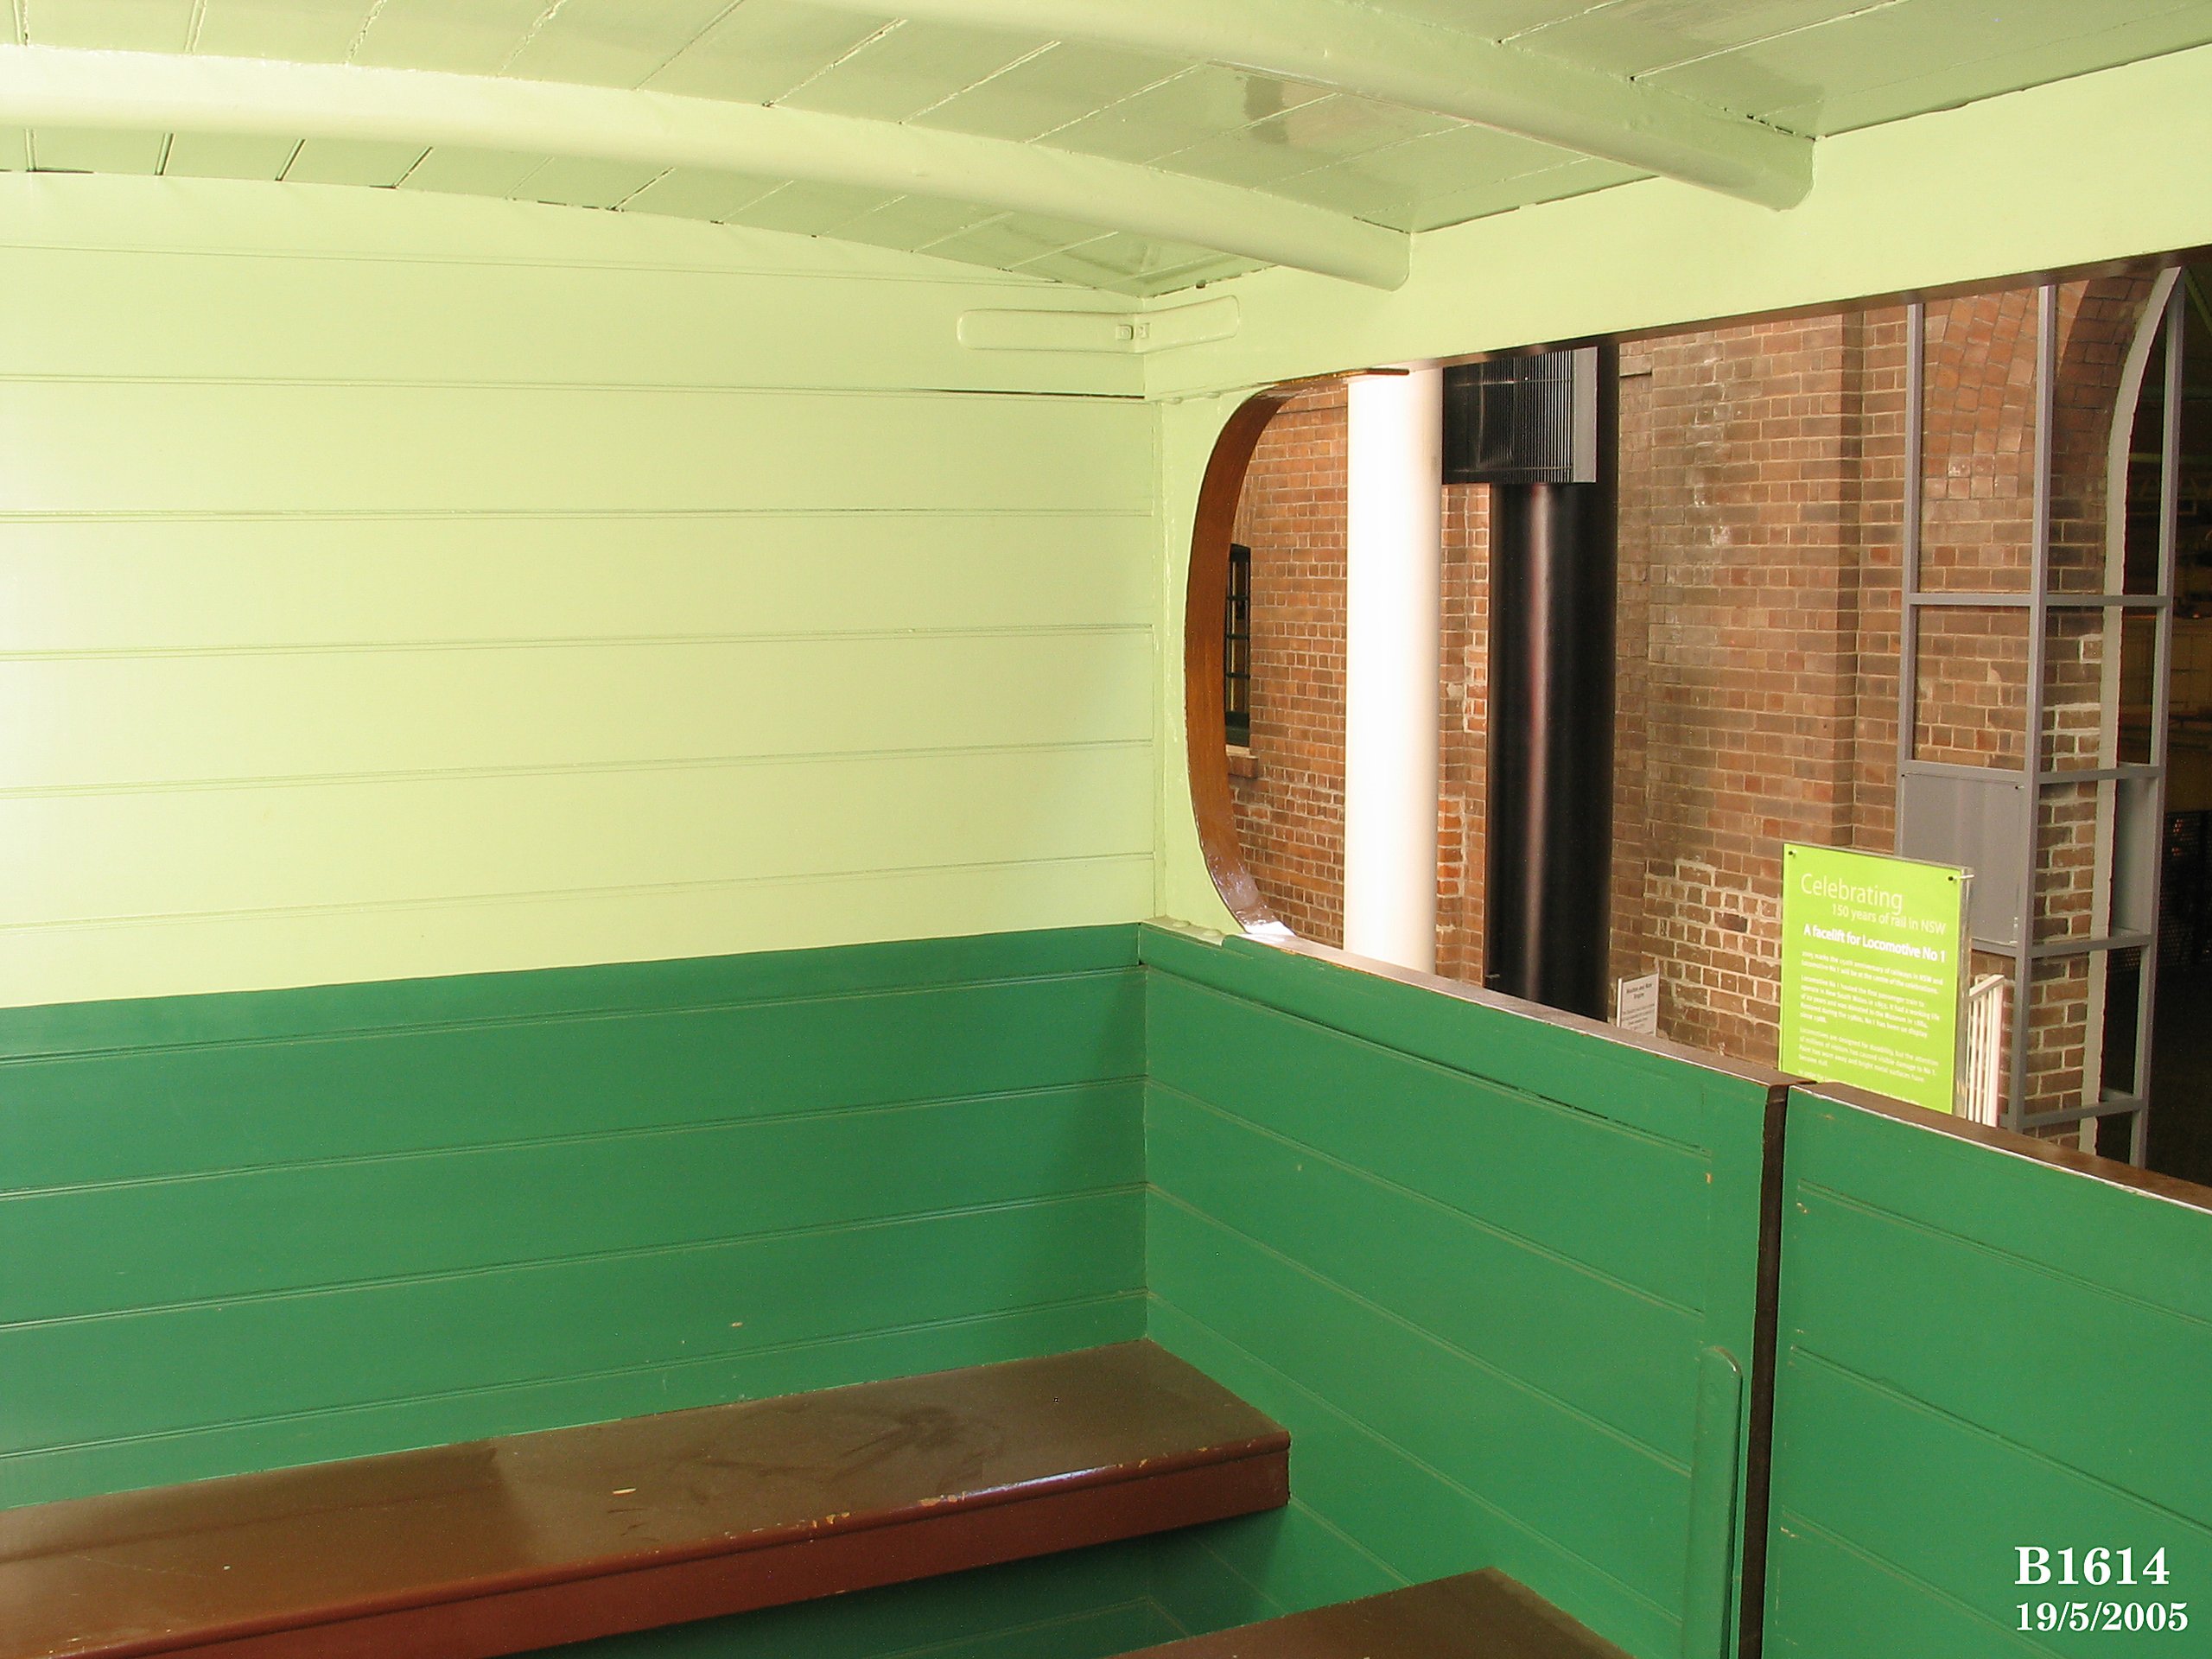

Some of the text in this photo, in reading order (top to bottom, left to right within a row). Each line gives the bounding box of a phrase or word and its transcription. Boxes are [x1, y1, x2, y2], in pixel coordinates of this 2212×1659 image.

[1801, 873, 1903, 915] Celebrating
[1833, 904, 1947, 935] 150 years of rail in NSW
[1804, 924, 1946, 963] A facelift for Locomotive No 1
